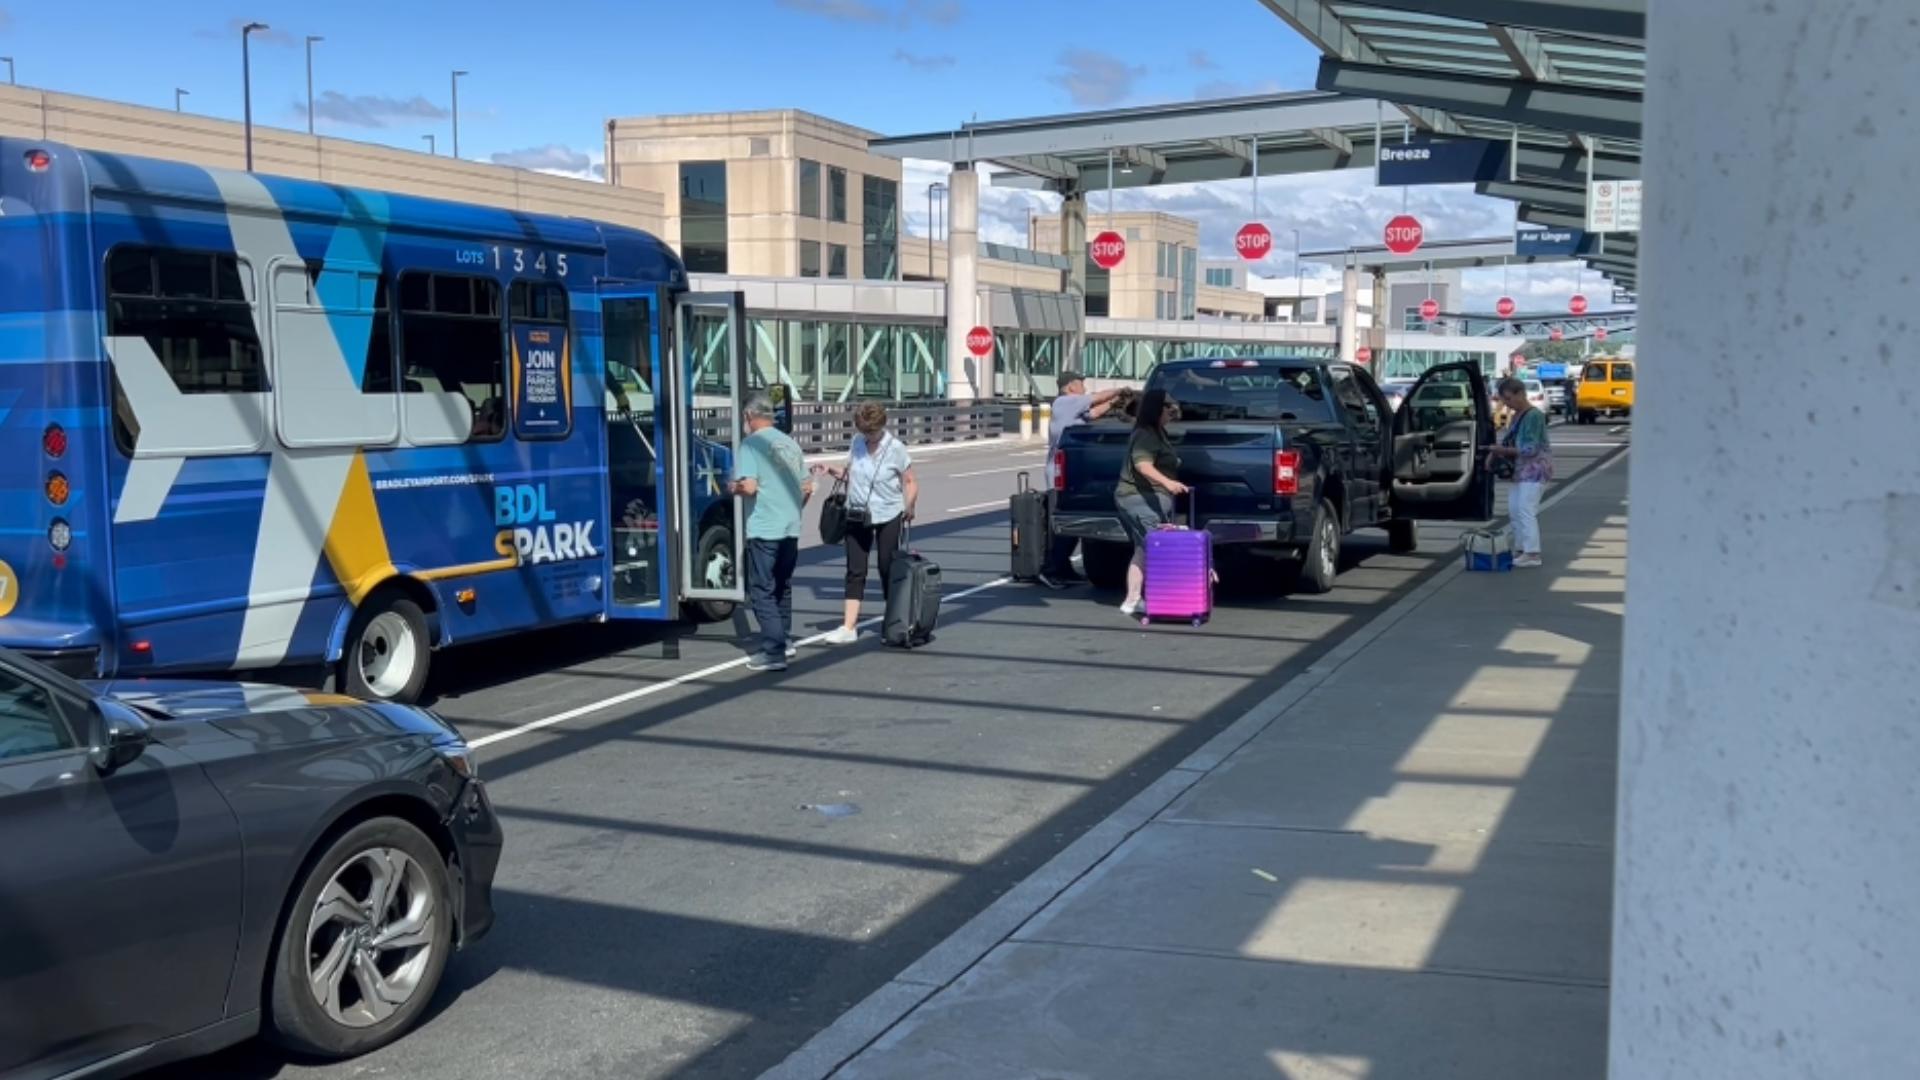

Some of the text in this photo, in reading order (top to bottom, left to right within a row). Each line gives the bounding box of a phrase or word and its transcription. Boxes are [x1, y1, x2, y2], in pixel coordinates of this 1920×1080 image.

[1381, 147, 1431, 161] Breeze
[1238, 233, 1269, 249] STOP
[1386, 227, 1421, 241] STOP
[1094, 241, 1123, 257] STOP
[456, 245, 569, 276] LOTS 1 3 4 5
[967, 334, 992, 347] STOP
[526, 350, 556, 369] JOIN
[495, 483, 556, 526] BDL
[495, 519, 597, 567] SPARK
